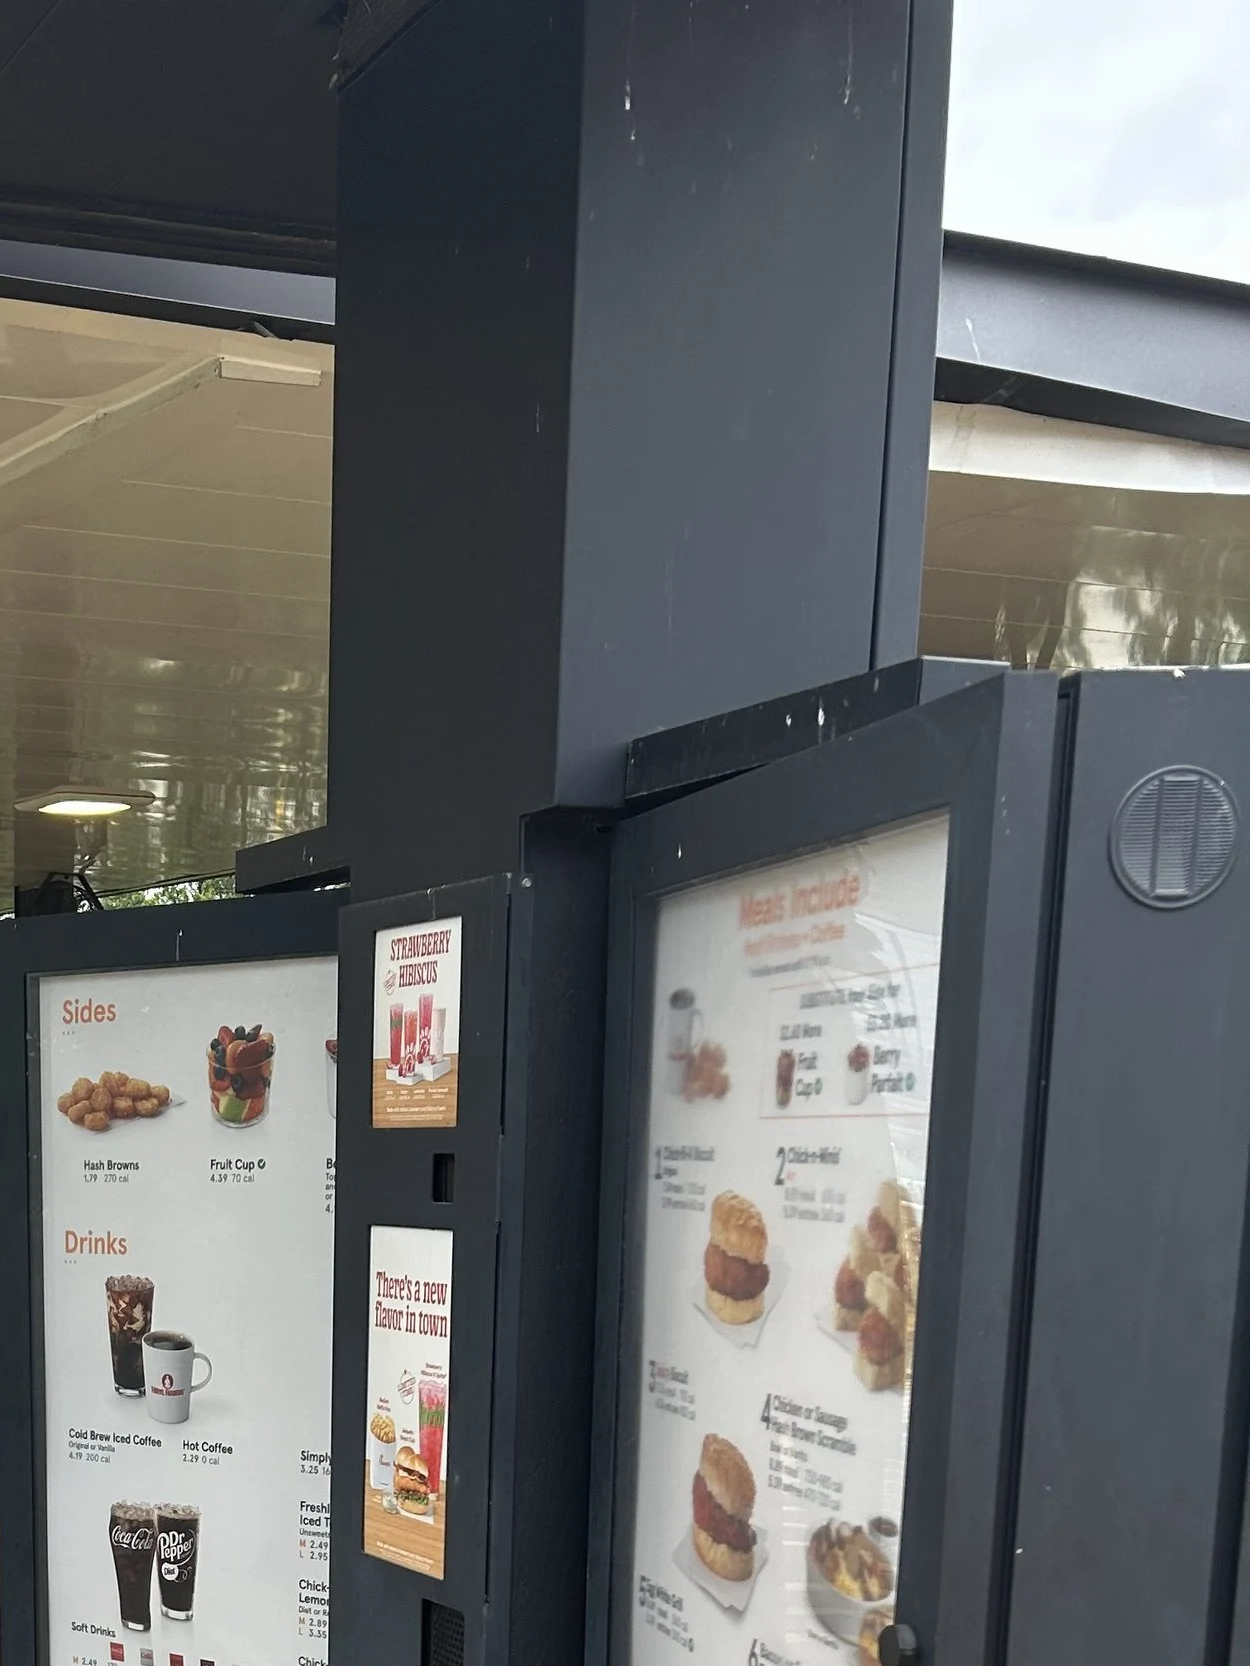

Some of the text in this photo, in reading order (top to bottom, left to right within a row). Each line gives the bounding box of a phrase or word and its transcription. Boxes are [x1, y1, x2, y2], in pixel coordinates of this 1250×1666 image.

[391, 929, 452, 961] STRAWBERRY
[399, 960, 438, 988] HIBISCUS
[62, 999, 116, 1025] Sides
[84, 1160, 140, 1171] Hash Browns
[210, 1159, 255, 1172] Fruit Cup
[774, 1147, 786, 1186] 2
[84, 1174, 129, 1183] 1.79 270 cal
[210, 1174, 255, 1183] 4.39 70 cal
[65, 1230, 128, 1255] Drinks
[376, 1271, 448, 1306] There's a new
[375, 1300, 448, 1338] flavor in town
[760, 1393, 771, 1430] 4
[69, 1428, 162, 1448] Cold Brew Iced Coffee
[183, 1440, 233, 1455] Hot Coffee
[68, 1452, 111, 1463] 4.19 200 cal
[182, 1454, 220, 1465] 2.29 0 cal
[300, 1464, 319, 1475] 3.25
[300, 1500, 330, 1514] Freshl
[300, 1514, 321, 1527] Iced
[112, 1525, 154, 1550] Coca-Cola
[168, 1531, 186, 1546] Dr
[300, 1539, 329, 1550] M 2.49
[157, 1532, 194, 1562] Pepper
[300, 1550, 328, 1561] L 2.95
[298, 1606, 312, 1615] Diet
[314, 1608, 321, 1616] or
[298, 1616, 327, 1628] M 2.89
[71, 1622, 116, 1638] Soft Drinks
[298, 1626, 327, 1639] L 3.35
[73, 1656, 97, 1666] M 2.49
